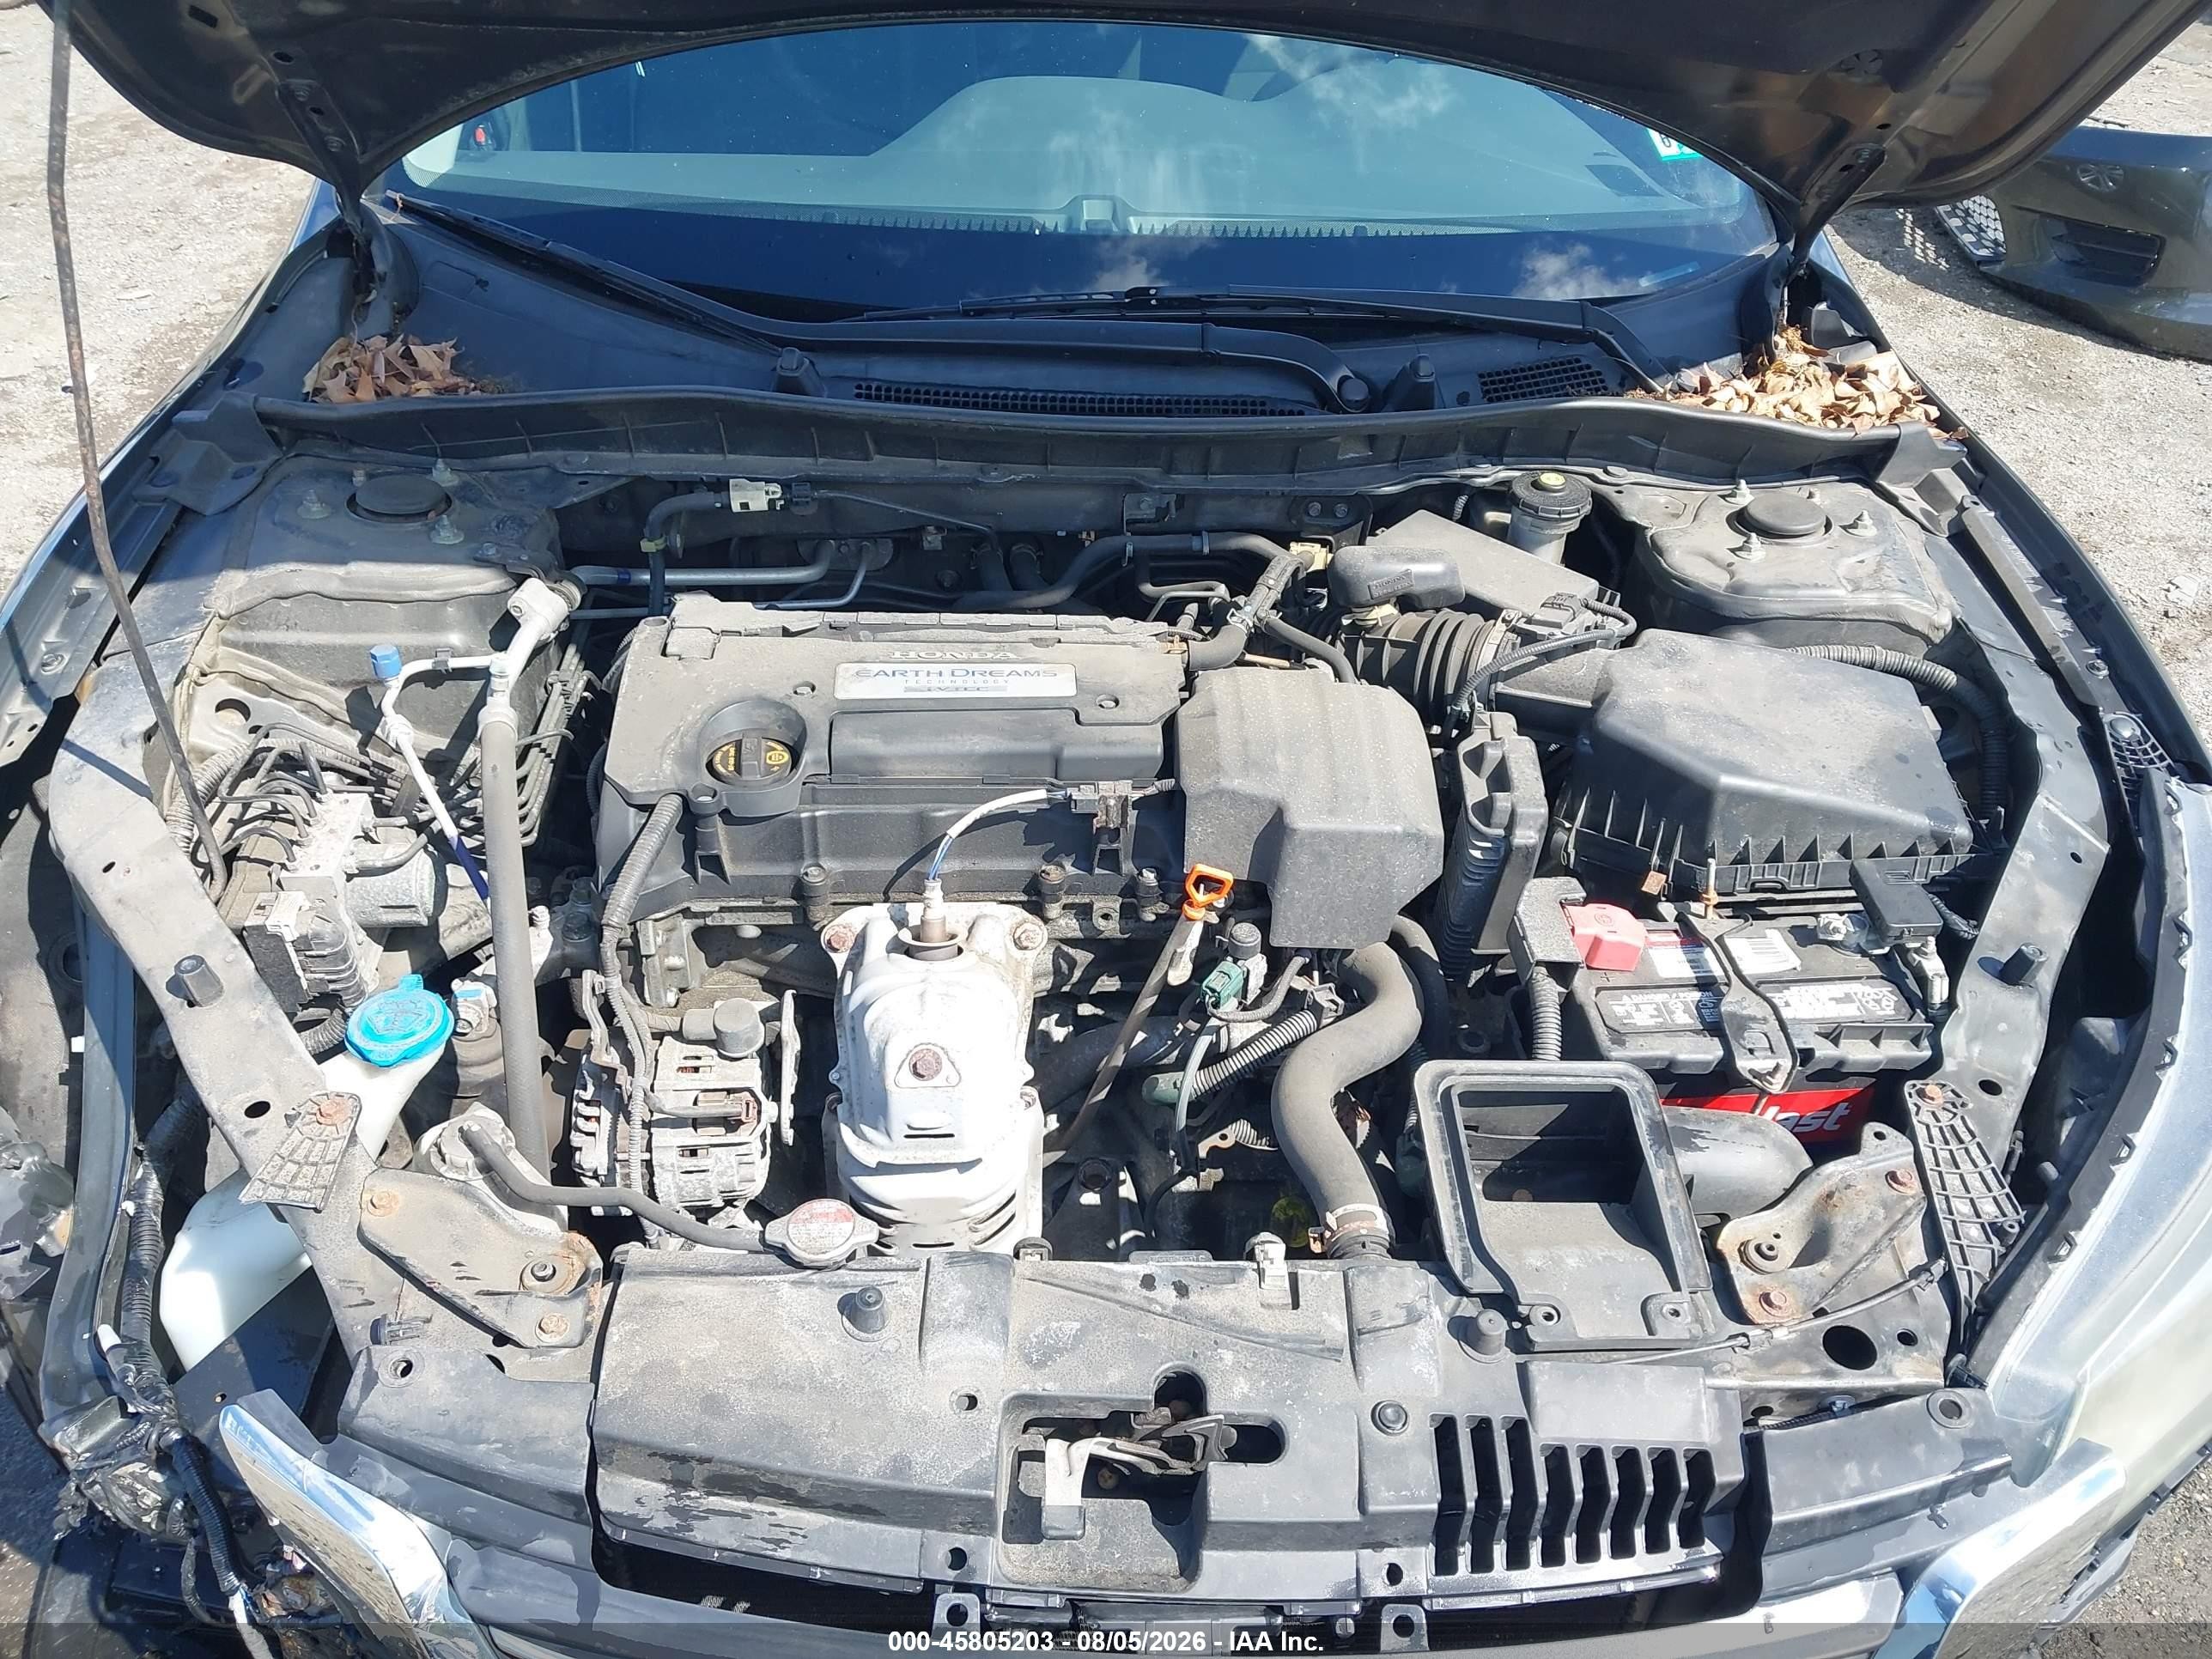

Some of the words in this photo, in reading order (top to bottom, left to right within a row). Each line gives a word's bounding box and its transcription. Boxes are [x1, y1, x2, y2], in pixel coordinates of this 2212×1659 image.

[890, 651, 1021, 660] HONDA
[855, 669, 943, 678] EARTH
[951, 668, 1058, 678] DREAMS
